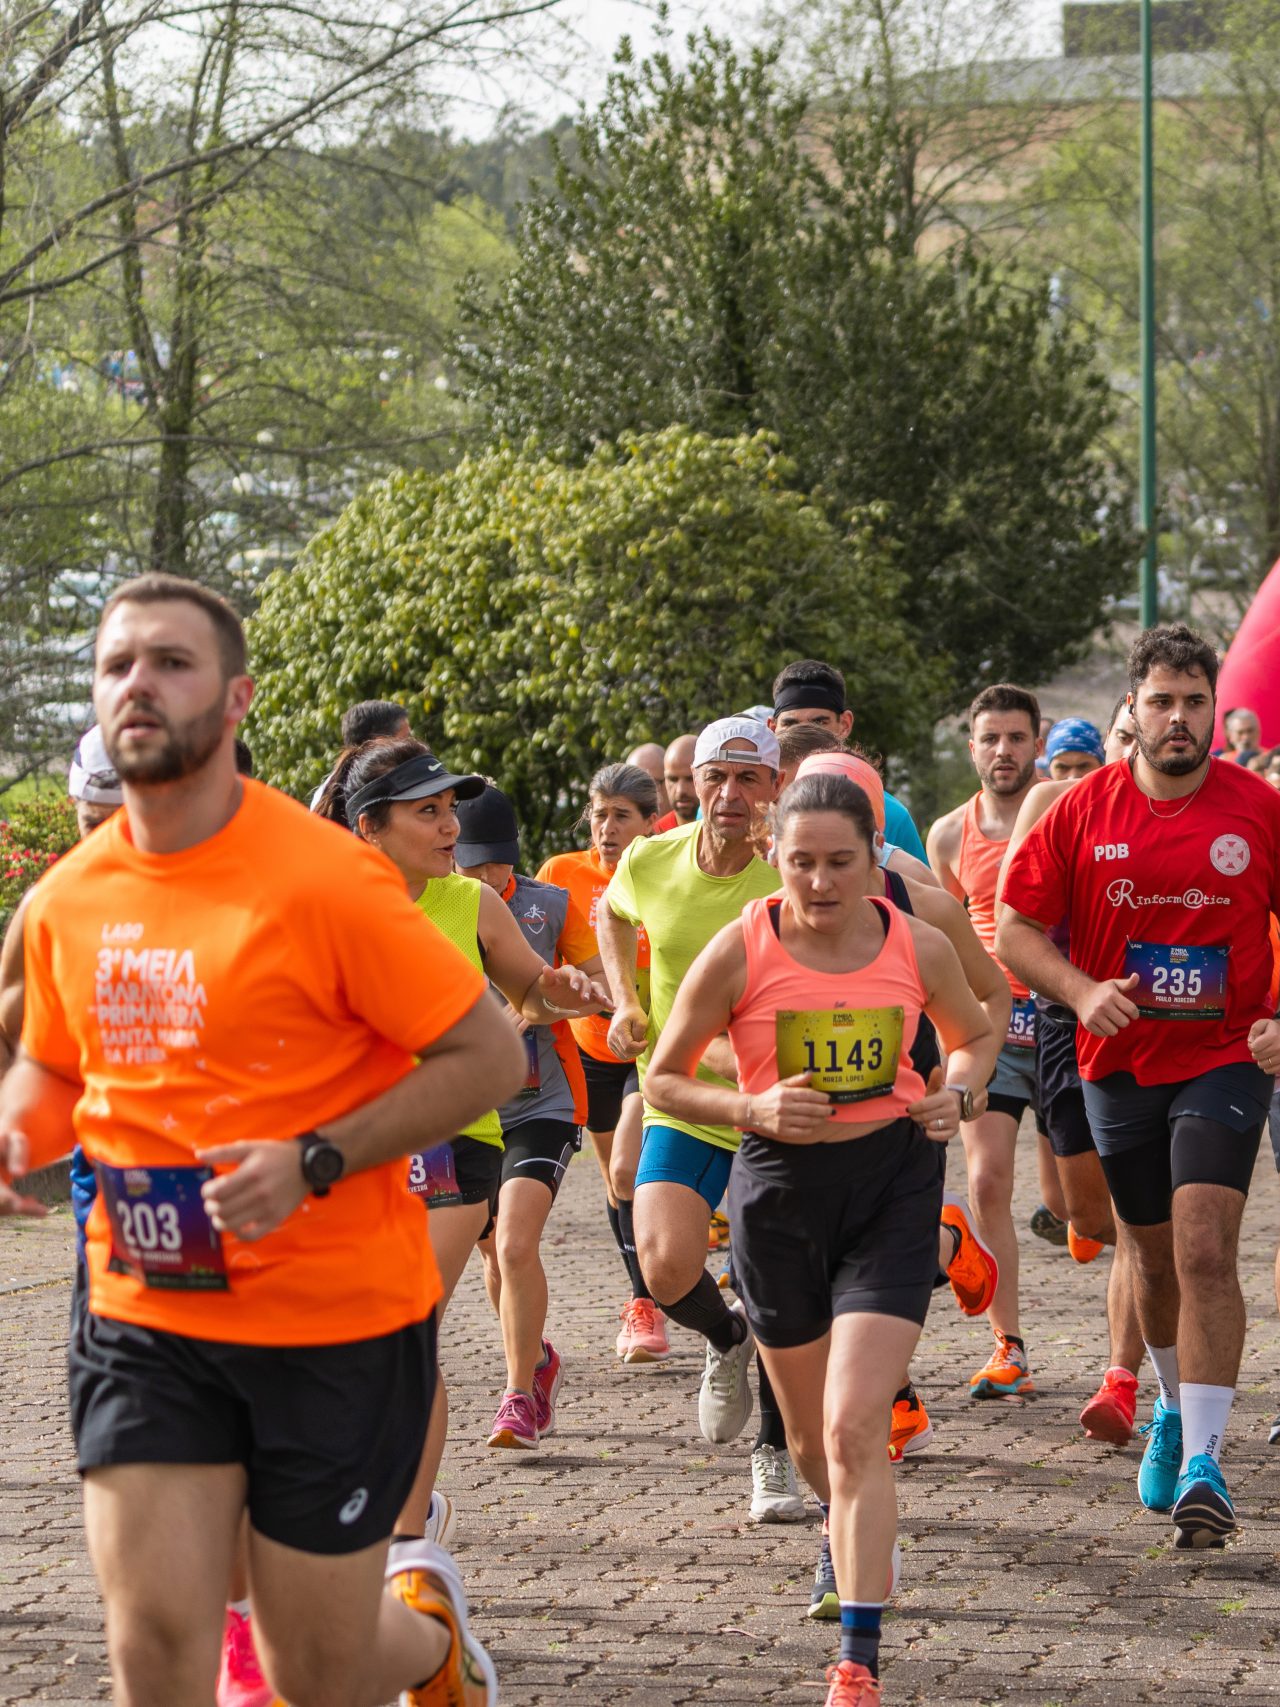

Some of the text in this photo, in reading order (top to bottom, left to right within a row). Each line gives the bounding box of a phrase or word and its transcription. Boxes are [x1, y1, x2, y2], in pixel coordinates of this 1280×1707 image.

[1094, 843, 1129, 862] PDB
[1152, 966, 1202, 996] 235
[1009, 1012, 1035, 1035] 52
[803, 1037, 883, 1073] 1143
[117, 1200, 182, 1251] 203
